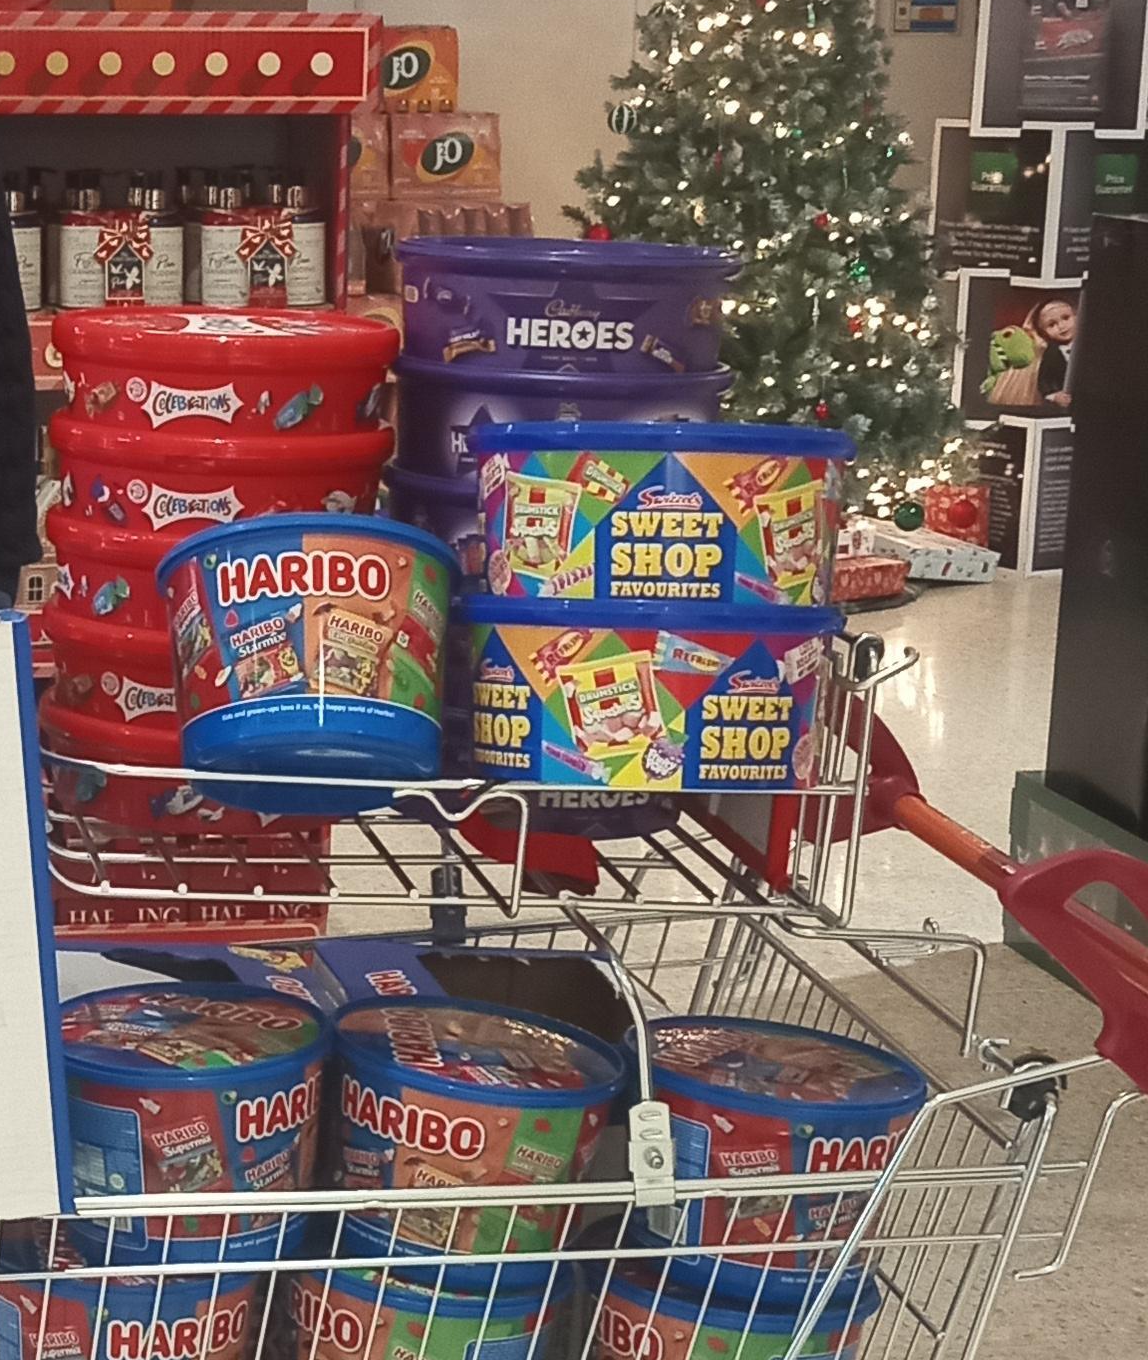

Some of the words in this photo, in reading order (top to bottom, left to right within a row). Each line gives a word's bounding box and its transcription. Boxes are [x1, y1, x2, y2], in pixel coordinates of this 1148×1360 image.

[980, 172, 1004, 183] Prce
[506, 316, 635, 351] HEROES
[610, 511, 724, 538] SWEET
[610, 542, 723, 578] SHOP
[218, 551, 390, 607] HARIBO
[610, 581, 722, 599] FAVOURITES
[230, 615, 285, 650] HARIBO
[327, 613, 385, 644] HARIBO
[237, 630, 288, 658] Starmix
[578, 679, 638, 703] DRUMSTICK
[702, 694, 794, 721] SWEET
[700, 726, 791, 760] SHOP
[474, 747, 531, 769] VOURITES
[698, 764, 789, 780] FAVOURITES
[237, 1071, 323, 1143] HARI
[342, 1074, 486, 1161] HARIBO
[152, 1120, 210, 1148] HARIBO
[162, 1134, 213, 1158] Supermix
[516, 1145, 565, 1170] HARIBO
[719, 1148, 779, 1168] HARIBO
